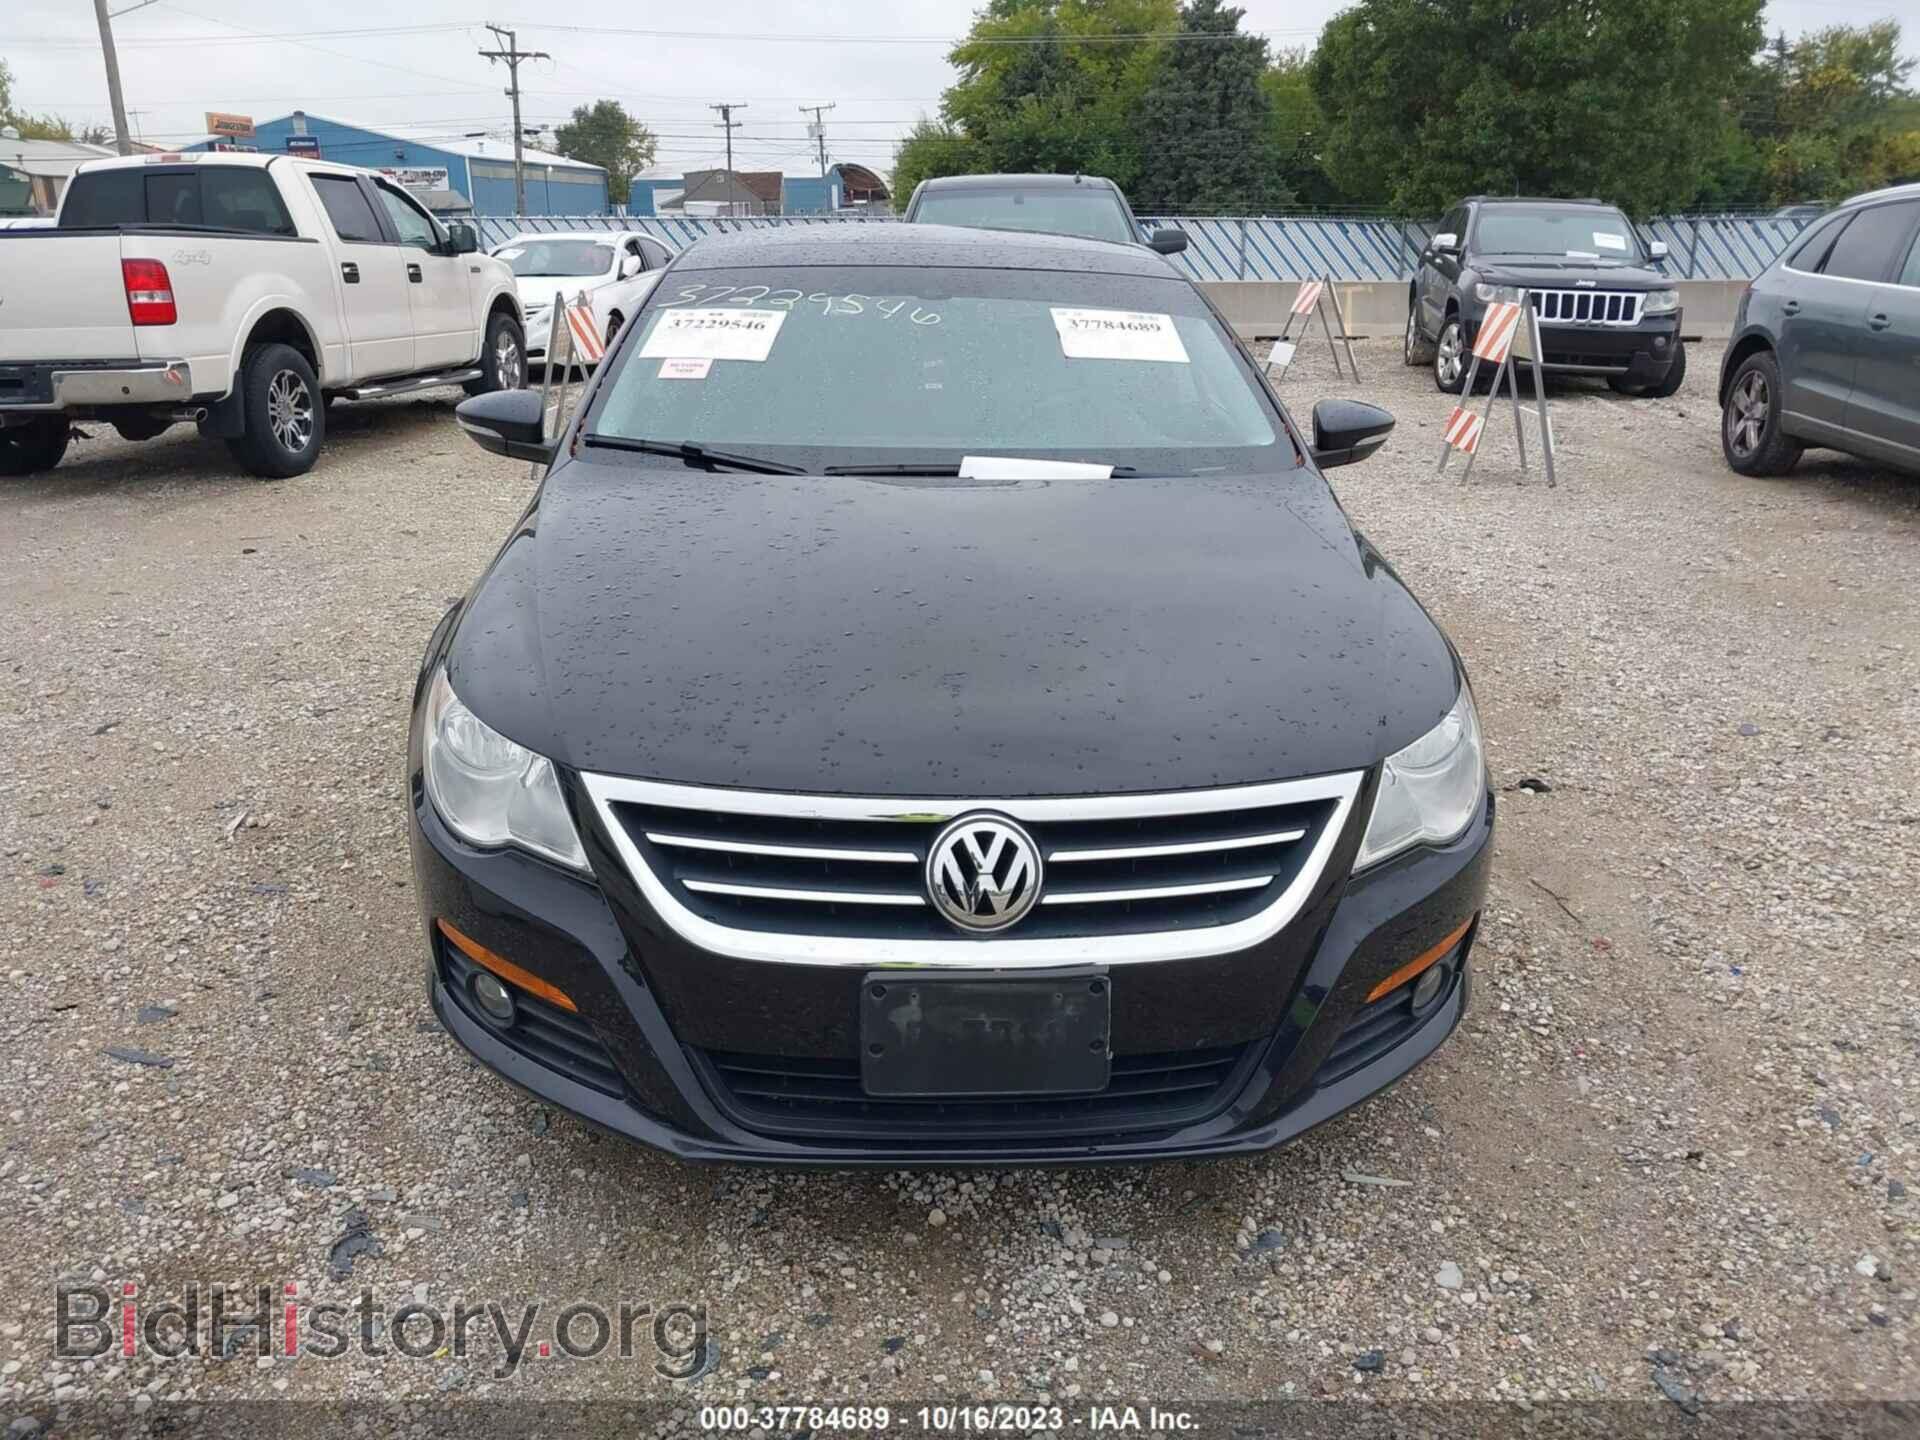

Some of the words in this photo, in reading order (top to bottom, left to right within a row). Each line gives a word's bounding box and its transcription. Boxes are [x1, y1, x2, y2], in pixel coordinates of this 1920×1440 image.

[657, 285, 942, 326] 37229546
[668, 318, 767, 331] 37229546
[1069, 319, 1162, 333] 37784689
